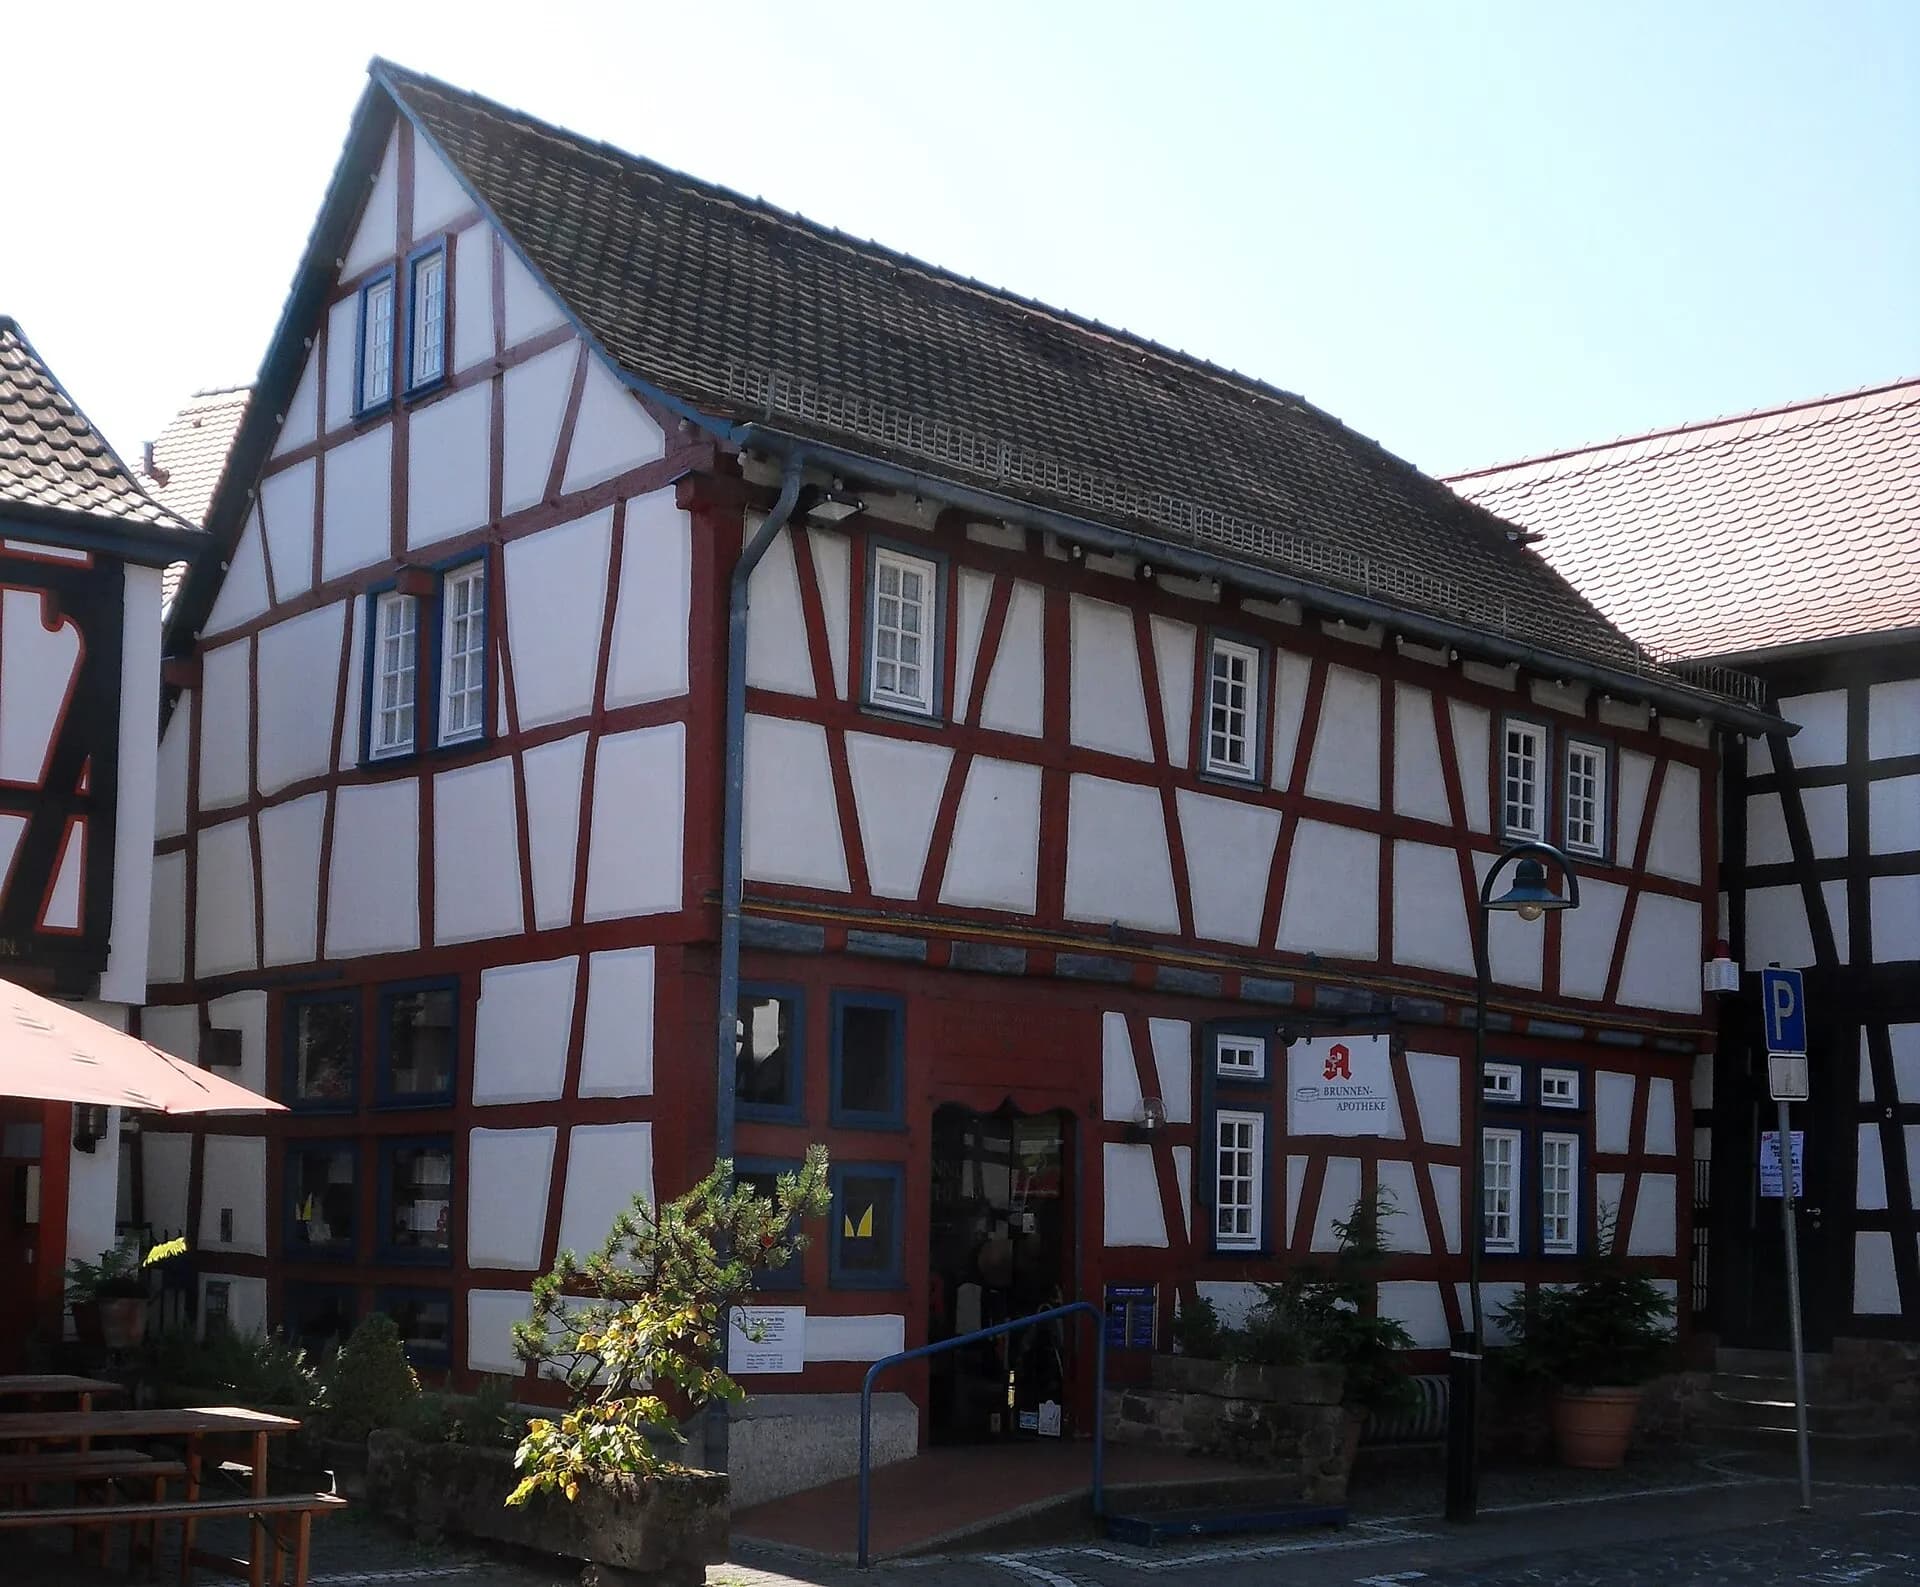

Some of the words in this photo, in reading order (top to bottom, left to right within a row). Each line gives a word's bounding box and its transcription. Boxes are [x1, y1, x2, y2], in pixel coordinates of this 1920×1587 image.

[1773, 979, 1795, 1041] P
[1323, 1086, 1373, 1096] BRUNNEN-
[1336, 1101, 1387, 1111] APOTHEKE
[1885, 1106, 1893, 1119] 3
